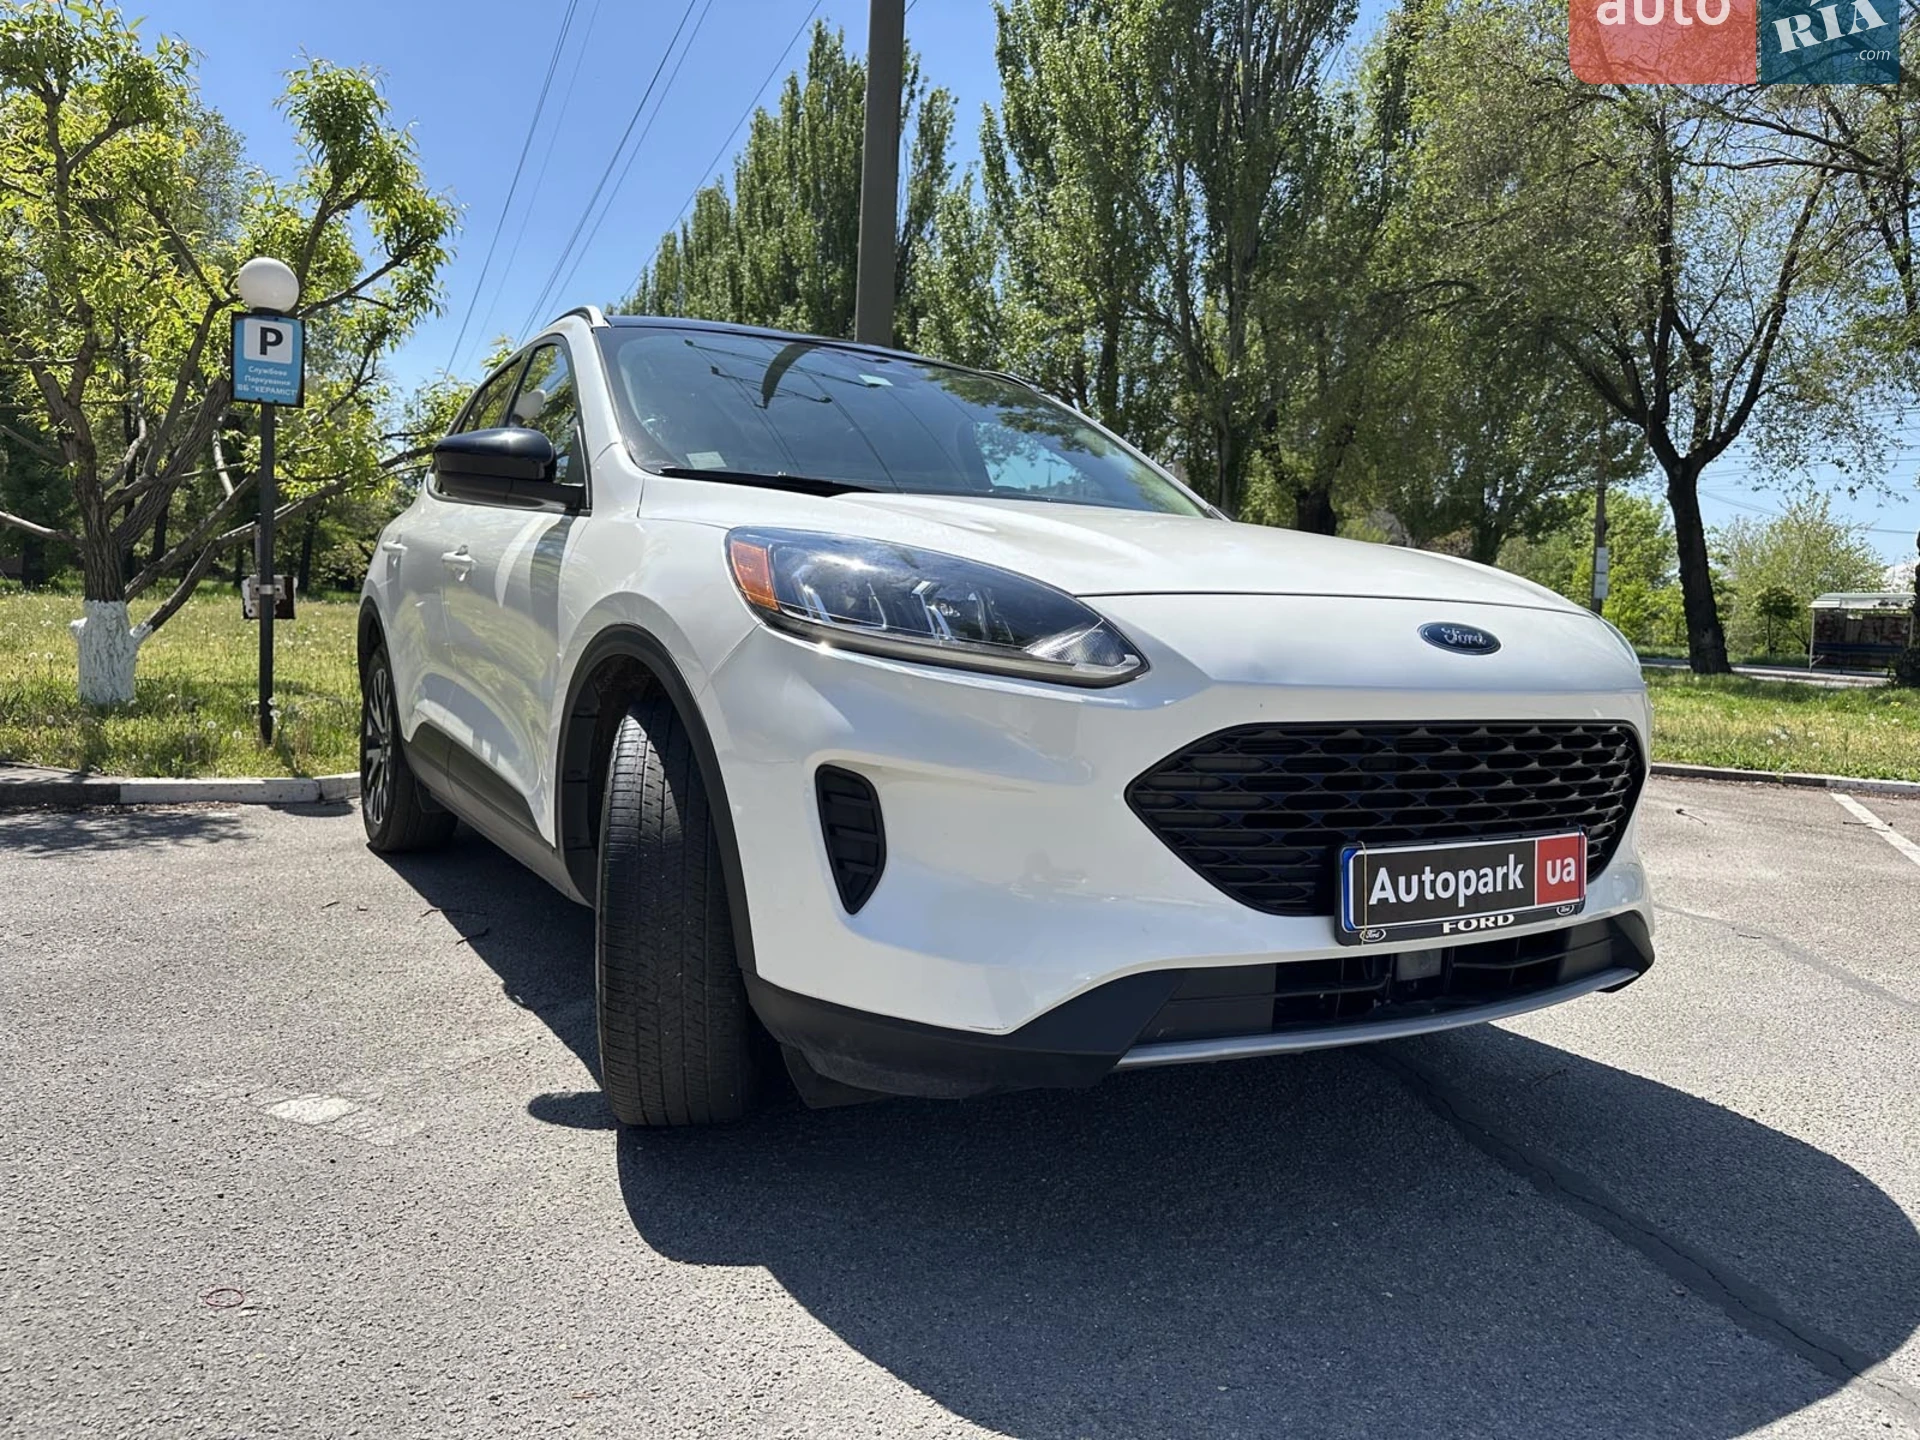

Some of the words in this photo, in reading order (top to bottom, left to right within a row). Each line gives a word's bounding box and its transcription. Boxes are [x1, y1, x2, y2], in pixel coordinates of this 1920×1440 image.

[260, 326, 284, 356] P
[1440, 627, 1487, 645] Ford
[1368, 853, 1525, 908] Autopark
[1546, 856, 1576, 886] ua
[1442, 913, 1515, 934] FORD
